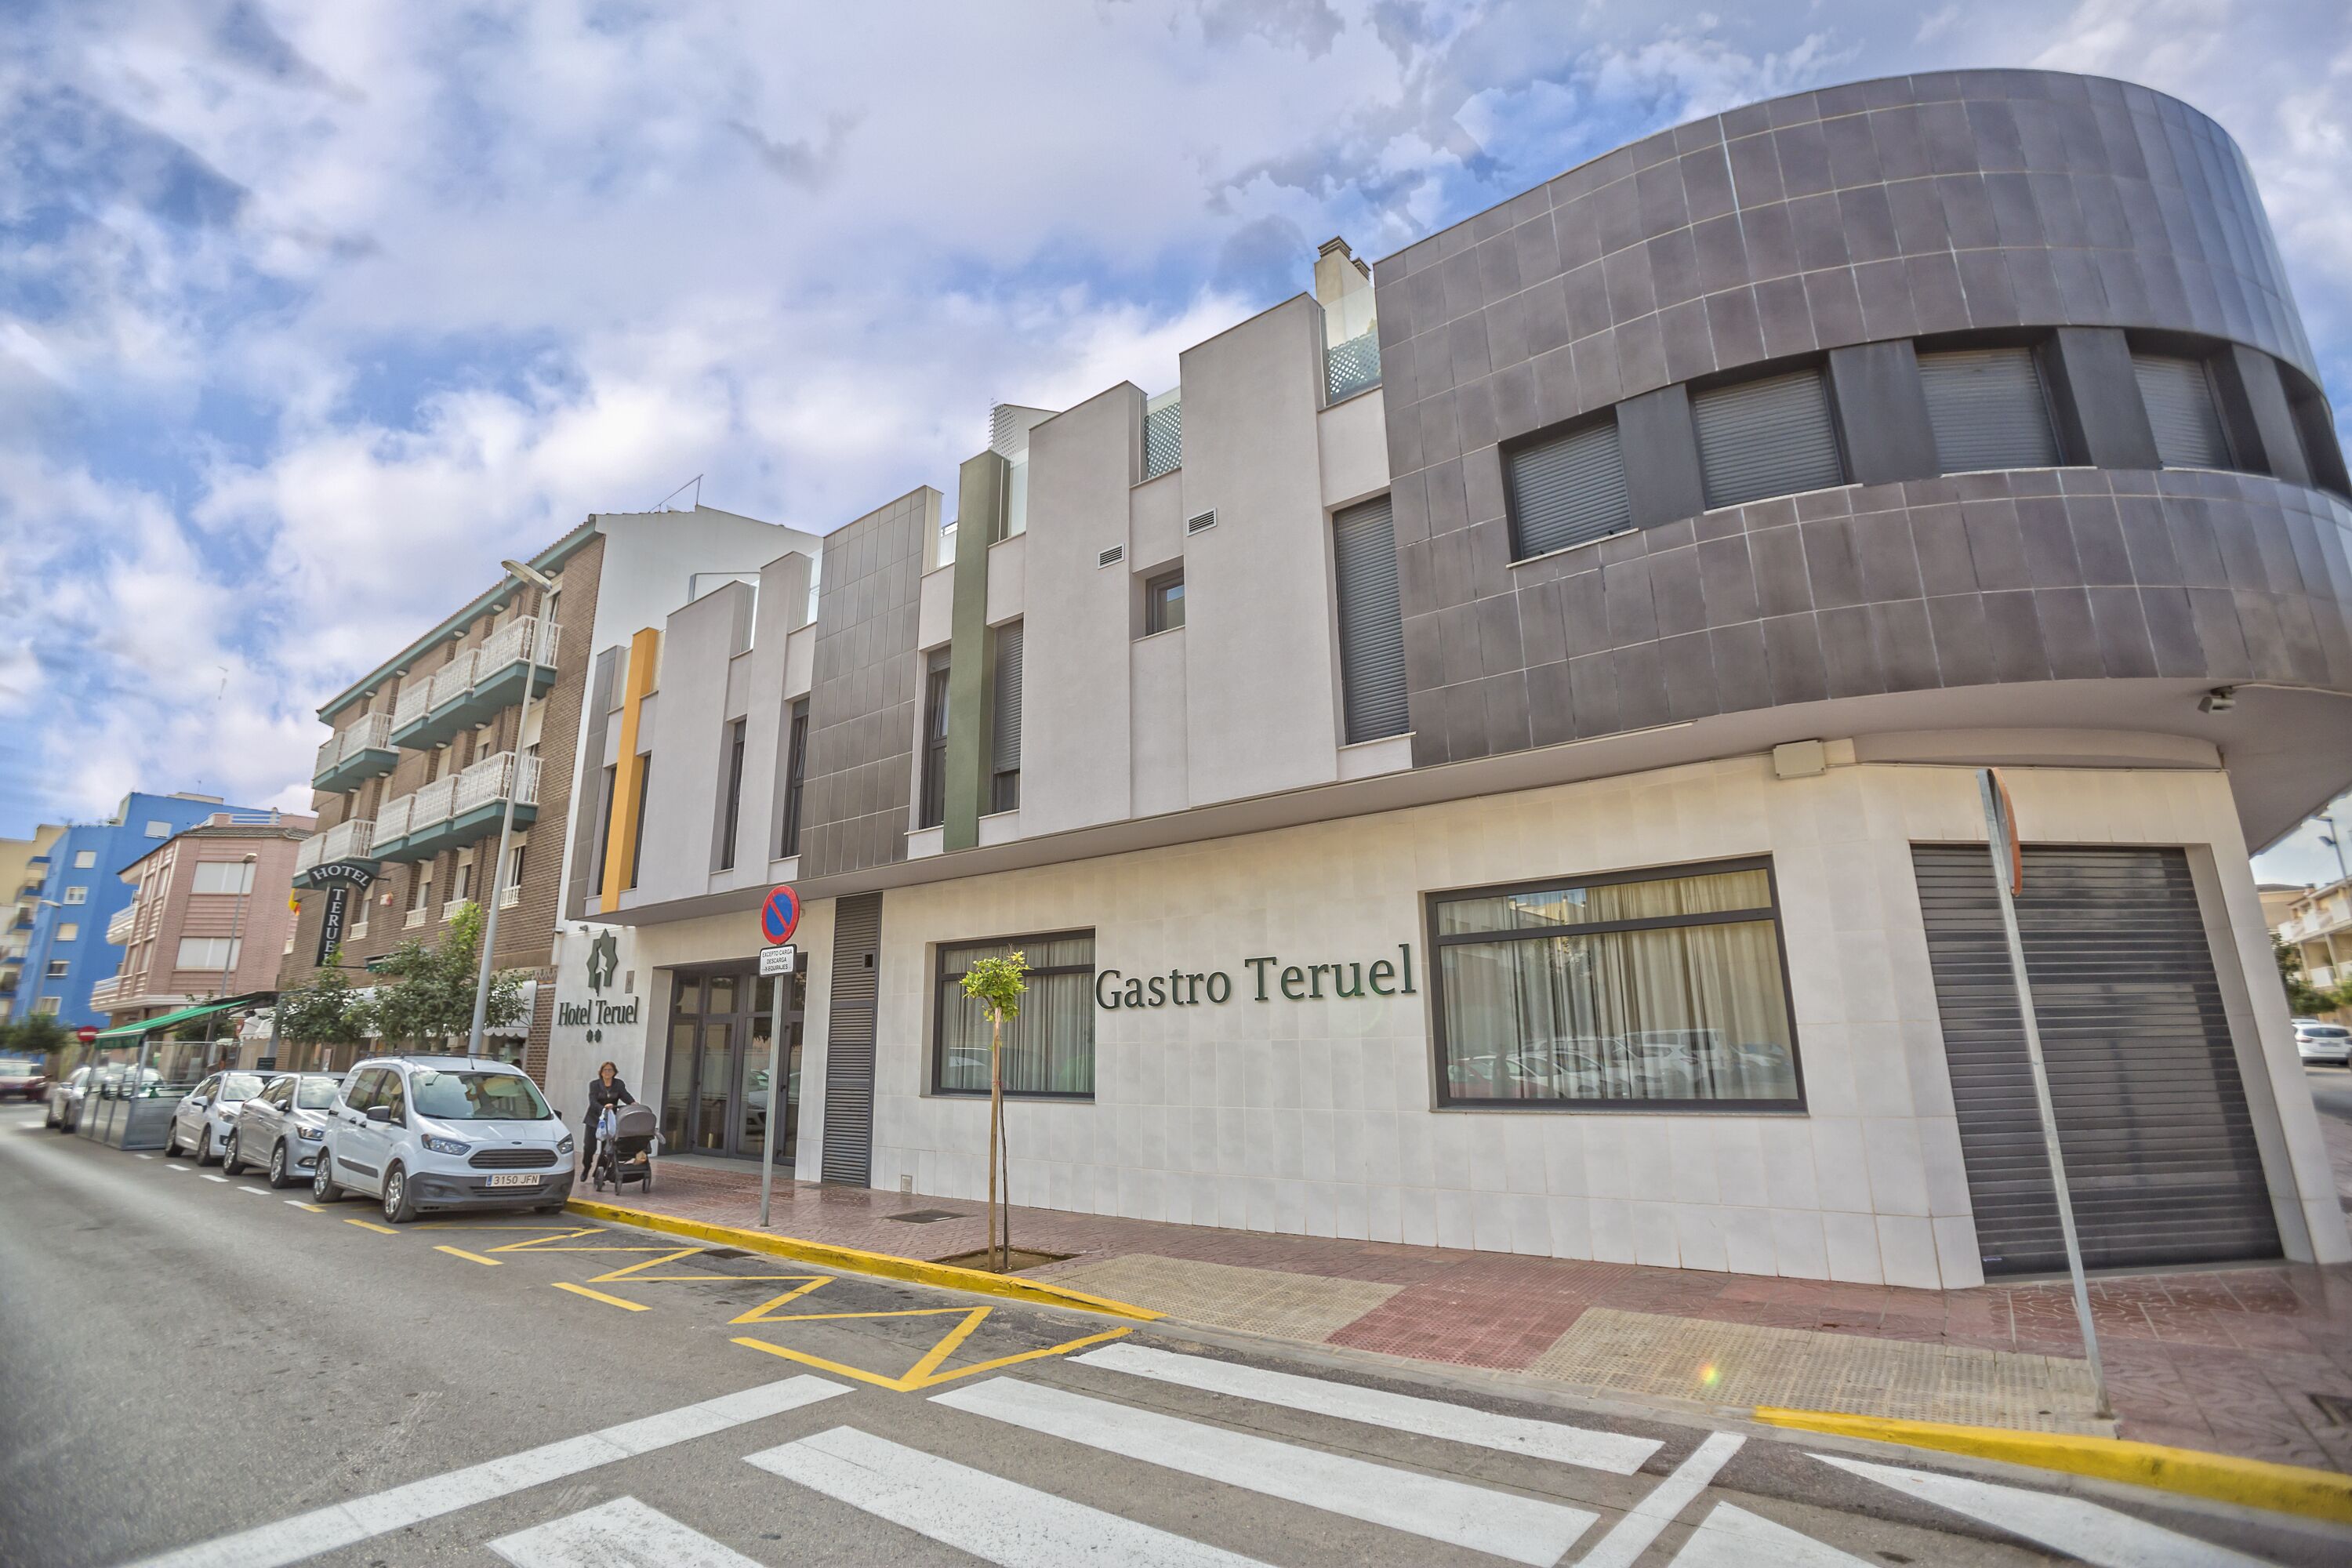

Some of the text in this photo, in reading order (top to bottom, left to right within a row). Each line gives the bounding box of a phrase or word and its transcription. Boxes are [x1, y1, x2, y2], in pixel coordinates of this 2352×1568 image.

[314, 866, 369, 887] HOTEL
[1096, 943, 1417, 1010] Gastro Teruel
[557, 996, 639, 1025] Hotel Teruel
[494, 1176, 517, 1185] 3150
